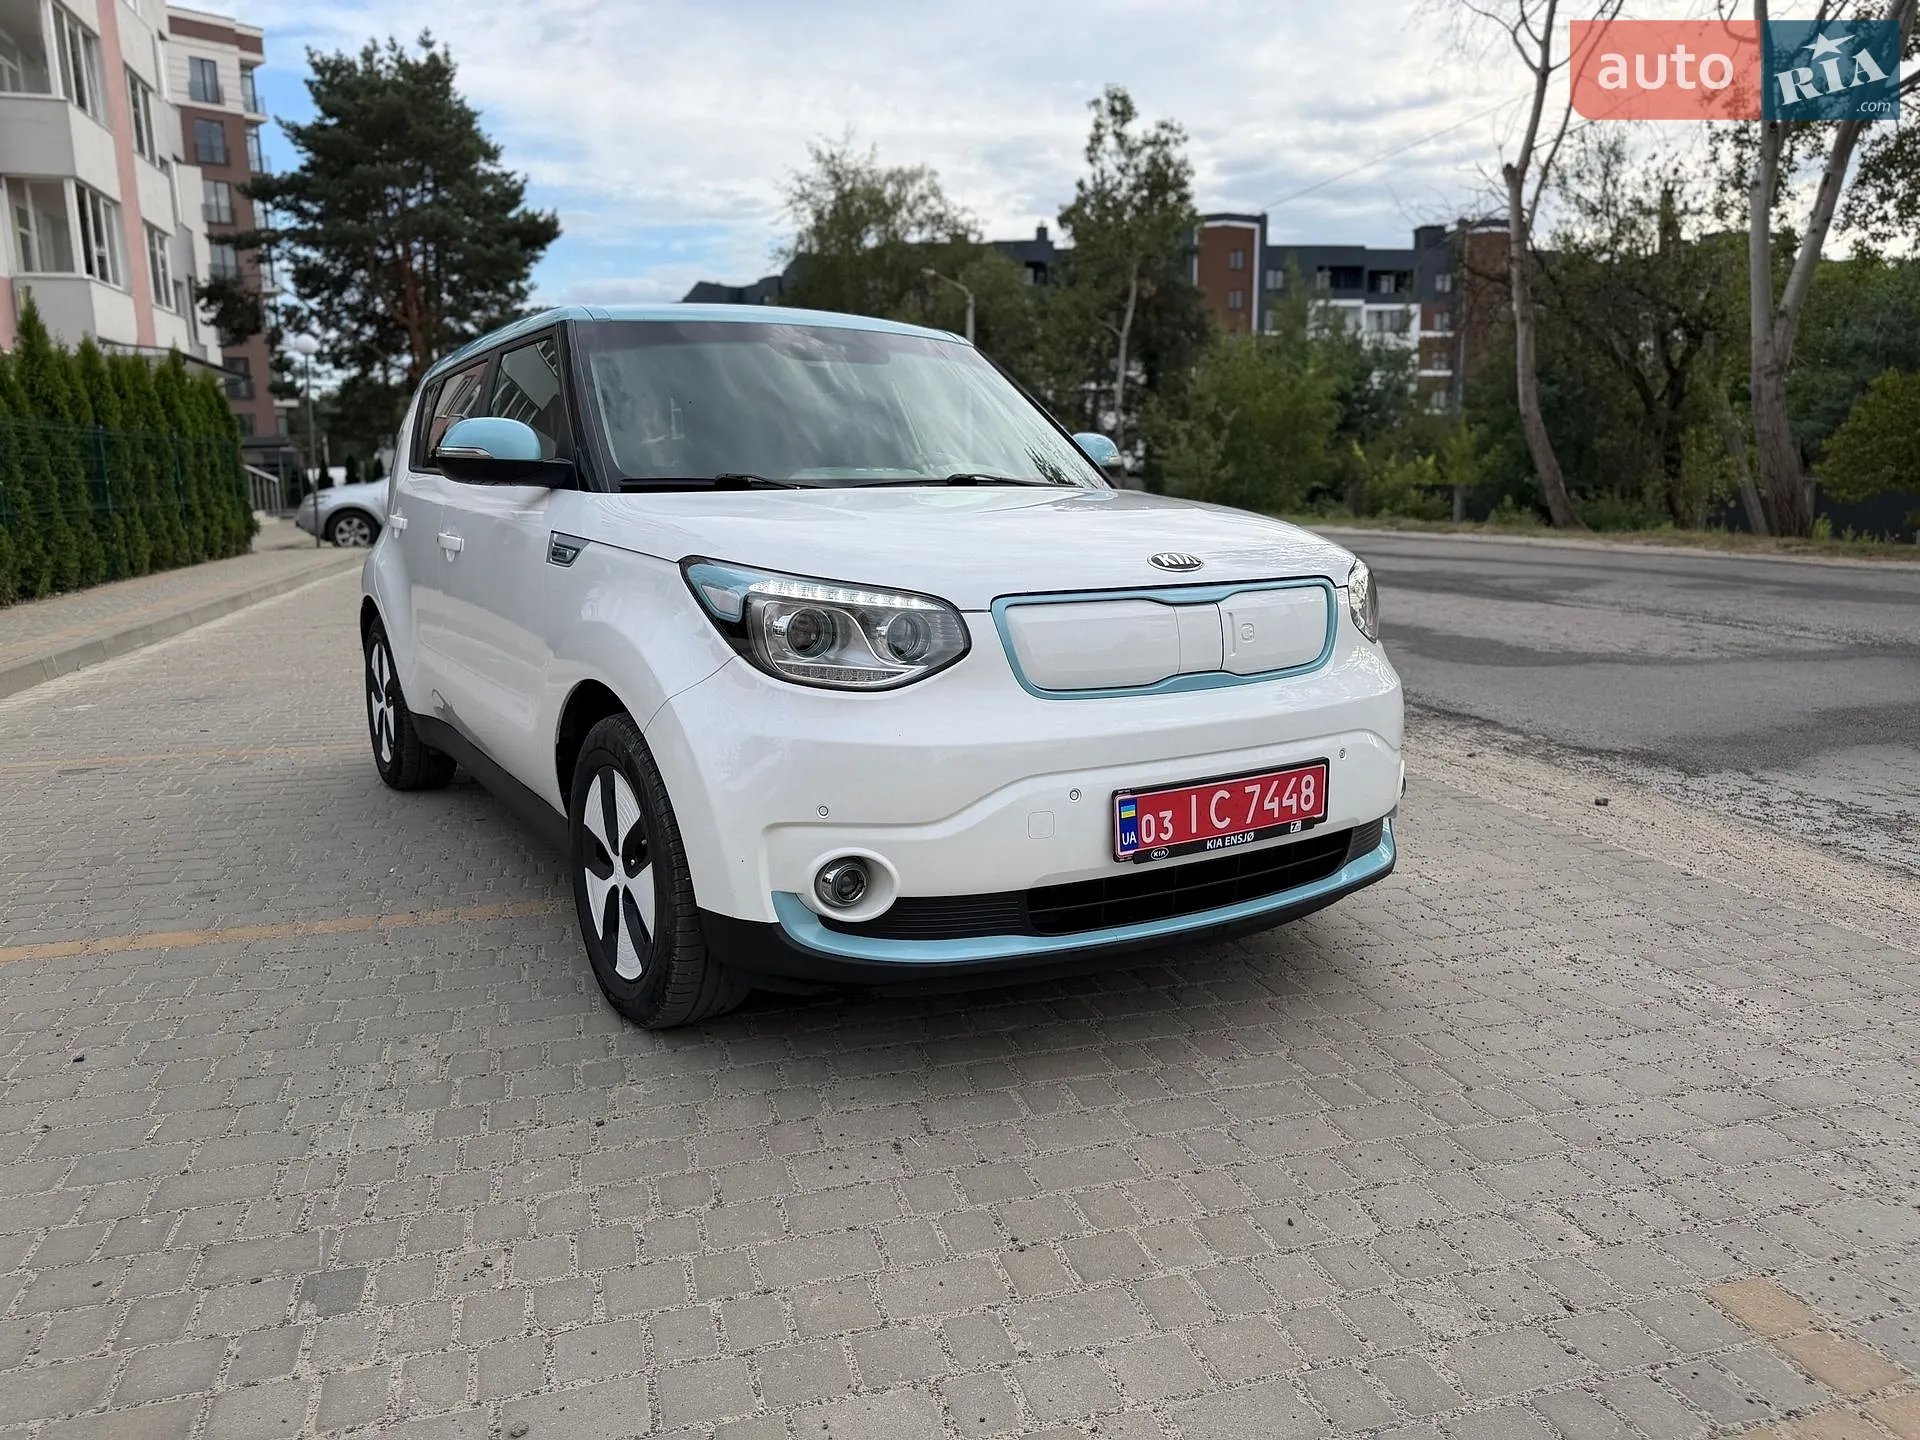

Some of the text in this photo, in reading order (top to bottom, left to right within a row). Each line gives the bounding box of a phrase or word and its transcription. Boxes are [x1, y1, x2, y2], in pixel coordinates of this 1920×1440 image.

[1154, 553, 1200, 566] KIA
[1141, 811, 1173, 844] 03
[1244, 775, 1316, 825] 7448
[1122, 831, 1137, 845] UA
[1206, 831, 1254, 850] KIA ENSJØ
